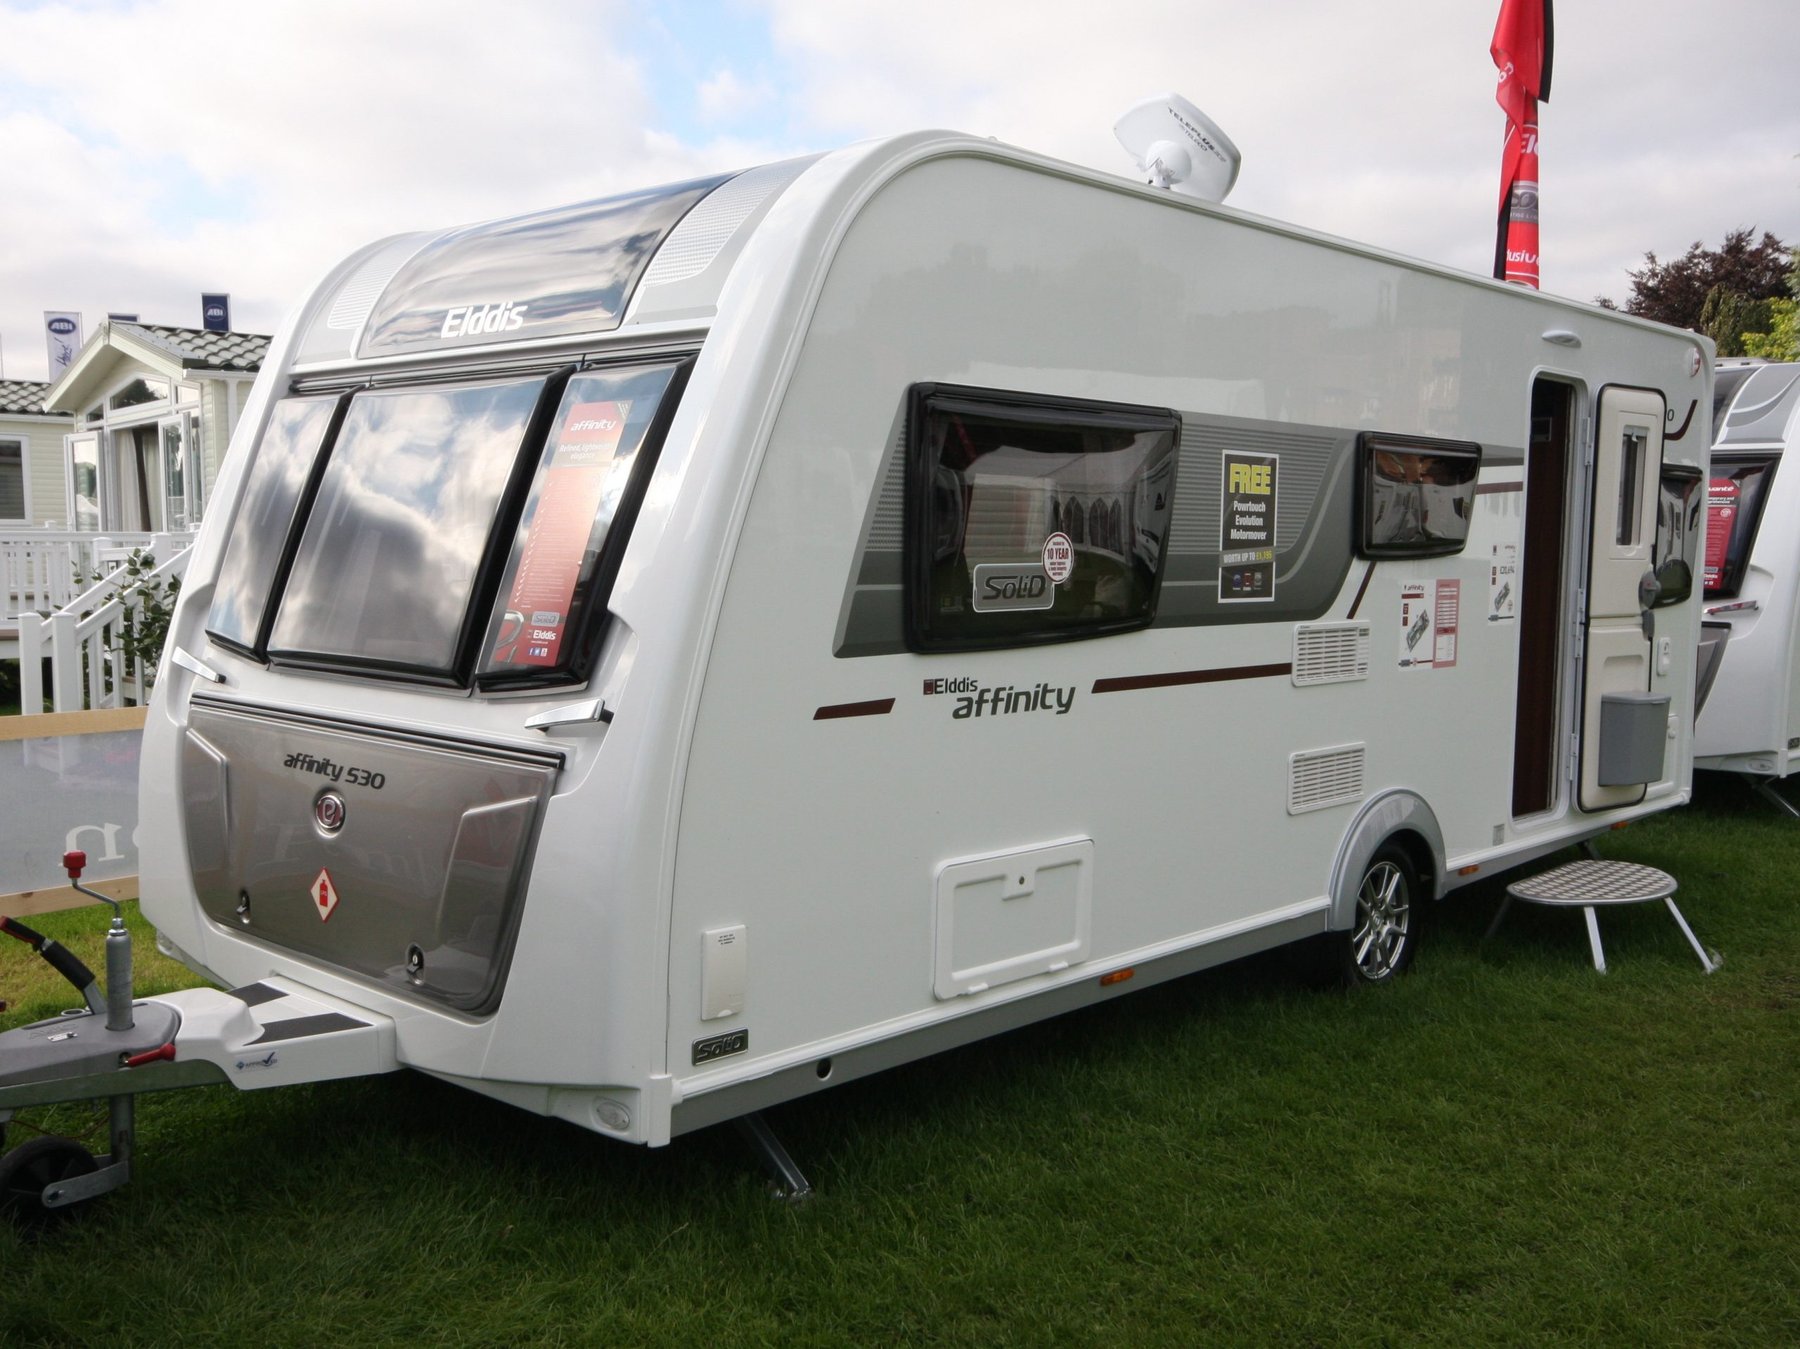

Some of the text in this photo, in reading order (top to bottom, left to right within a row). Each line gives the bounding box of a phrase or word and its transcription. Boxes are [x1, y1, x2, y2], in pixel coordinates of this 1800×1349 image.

[207, 308, 223, 317] ABI
[441, 301, 528, 338] Elddis
[50, 321, 73, 331] ABI
[570, 419, 616, 431] affinity
[1229, 463, 1271, 495] FREE
[1233, 501, 1266, 512] Powrtouch
[1235, 515, 1263, 526] Evolution
[1230, 529, 1267, 540] Motormover
[1055, 548, 1069, 560] YEAR
[1241, 552, 1249, 562] UP
[1249, 551, 1256, 561] TO
[533, 629, 556, 640] Elddis
[934, 677, 978, 695] Elddis
[952, 683, 1076, 720] affinity
[284, 752, 385, 790] affinity 530
